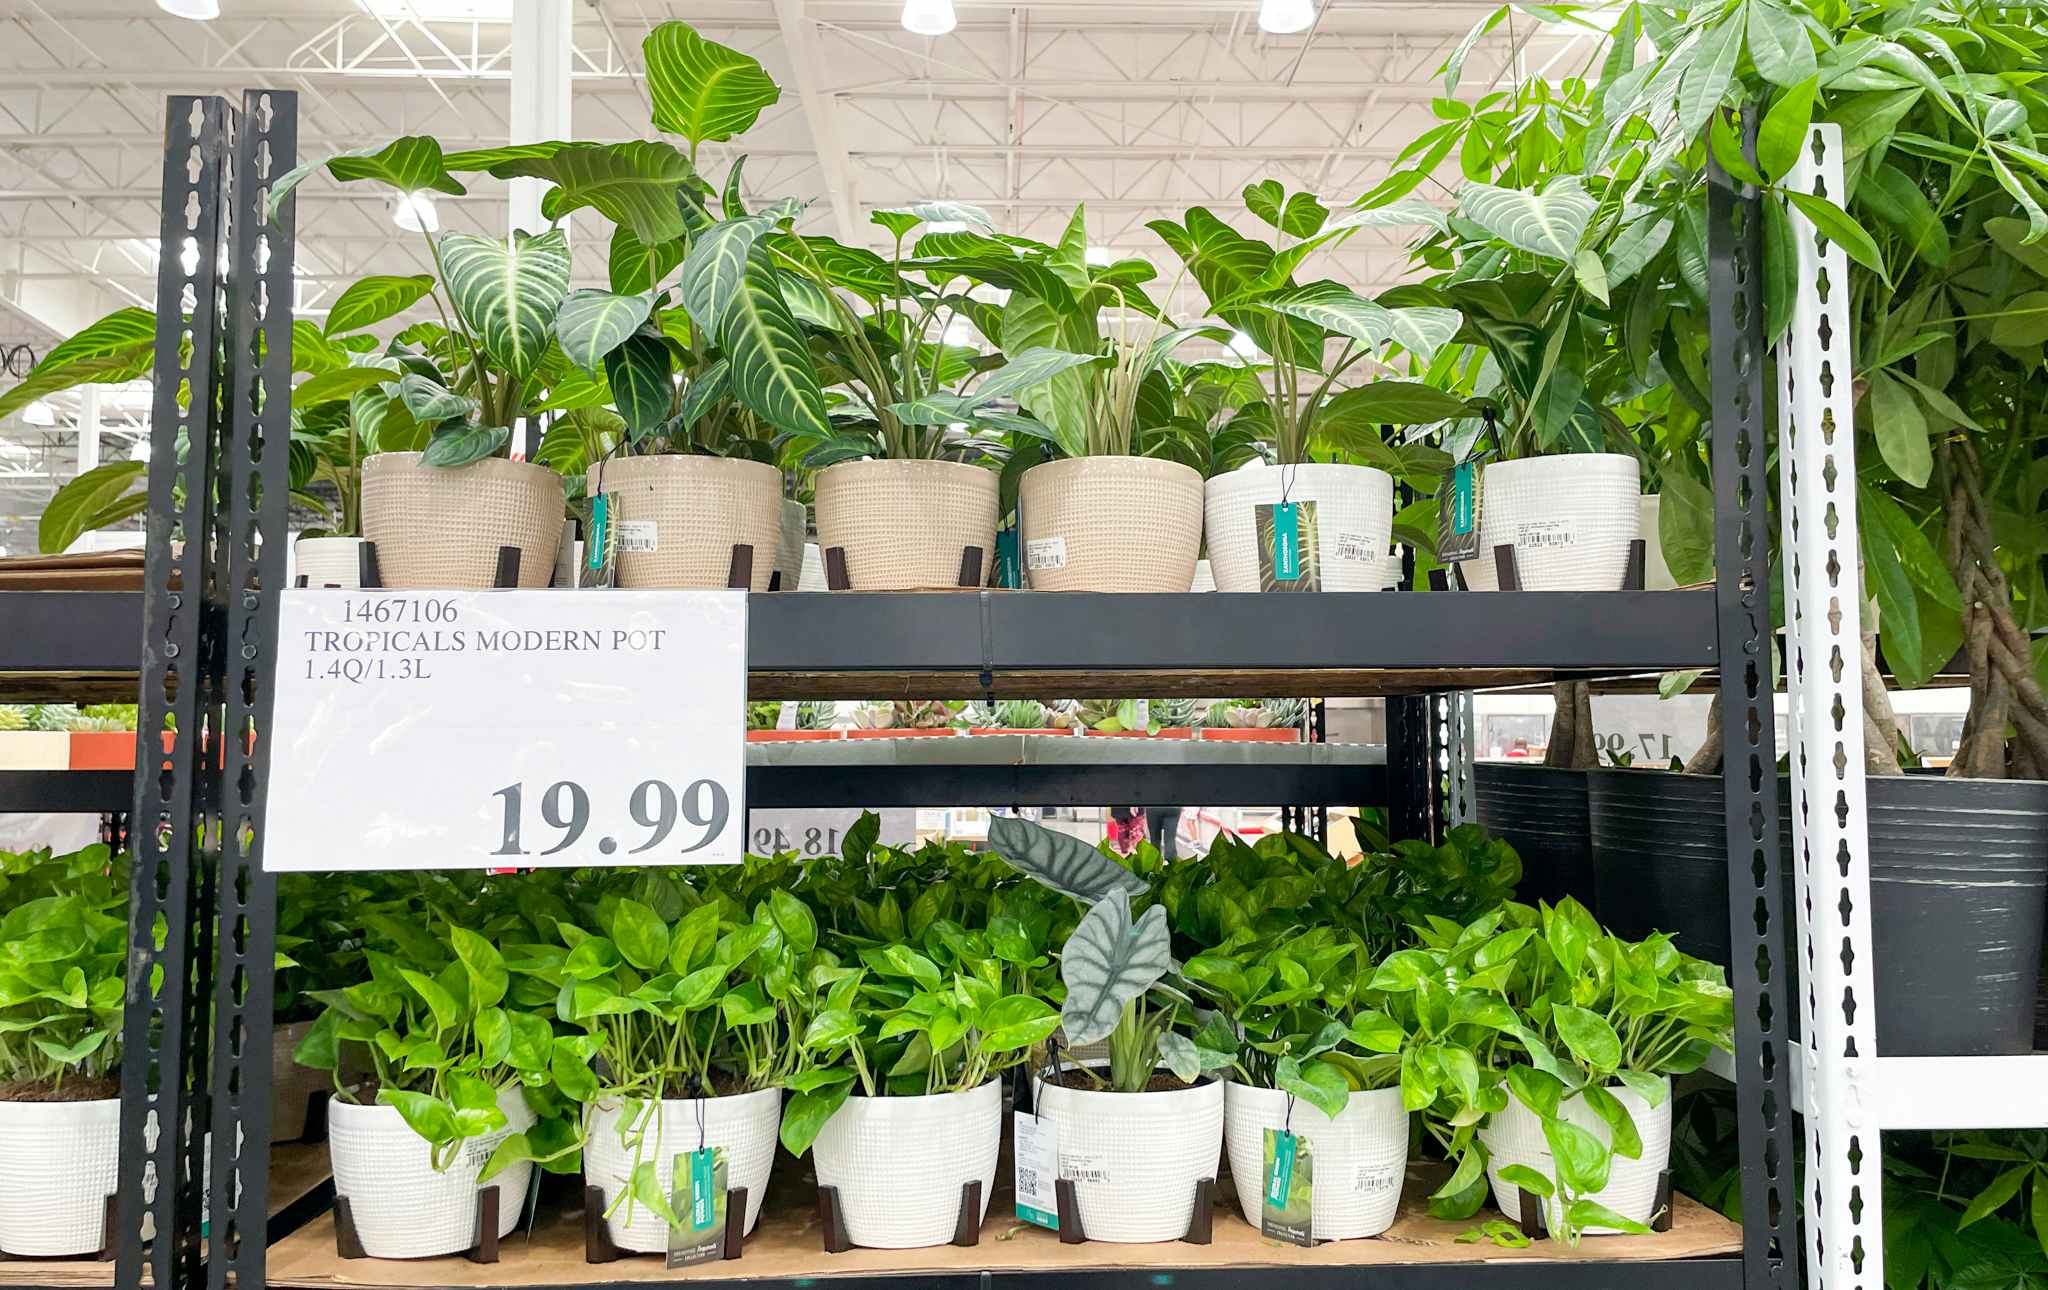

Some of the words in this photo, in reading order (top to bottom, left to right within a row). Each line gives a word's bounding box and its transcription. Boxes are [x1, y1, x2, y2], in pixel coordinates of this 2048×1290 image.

[1281, 532, 1289, 574] XANTHOSOMA
[344, 599, 458, 623] 1467106
[304, 630, 466, 652] TROPICALS
[476, 630, 602, 652] MODERN
[612, 630, 667, 651] POT
[304, 658, 432, 685] 1.4Q/1.3L
[489, 778, 730, 856] 19.99
